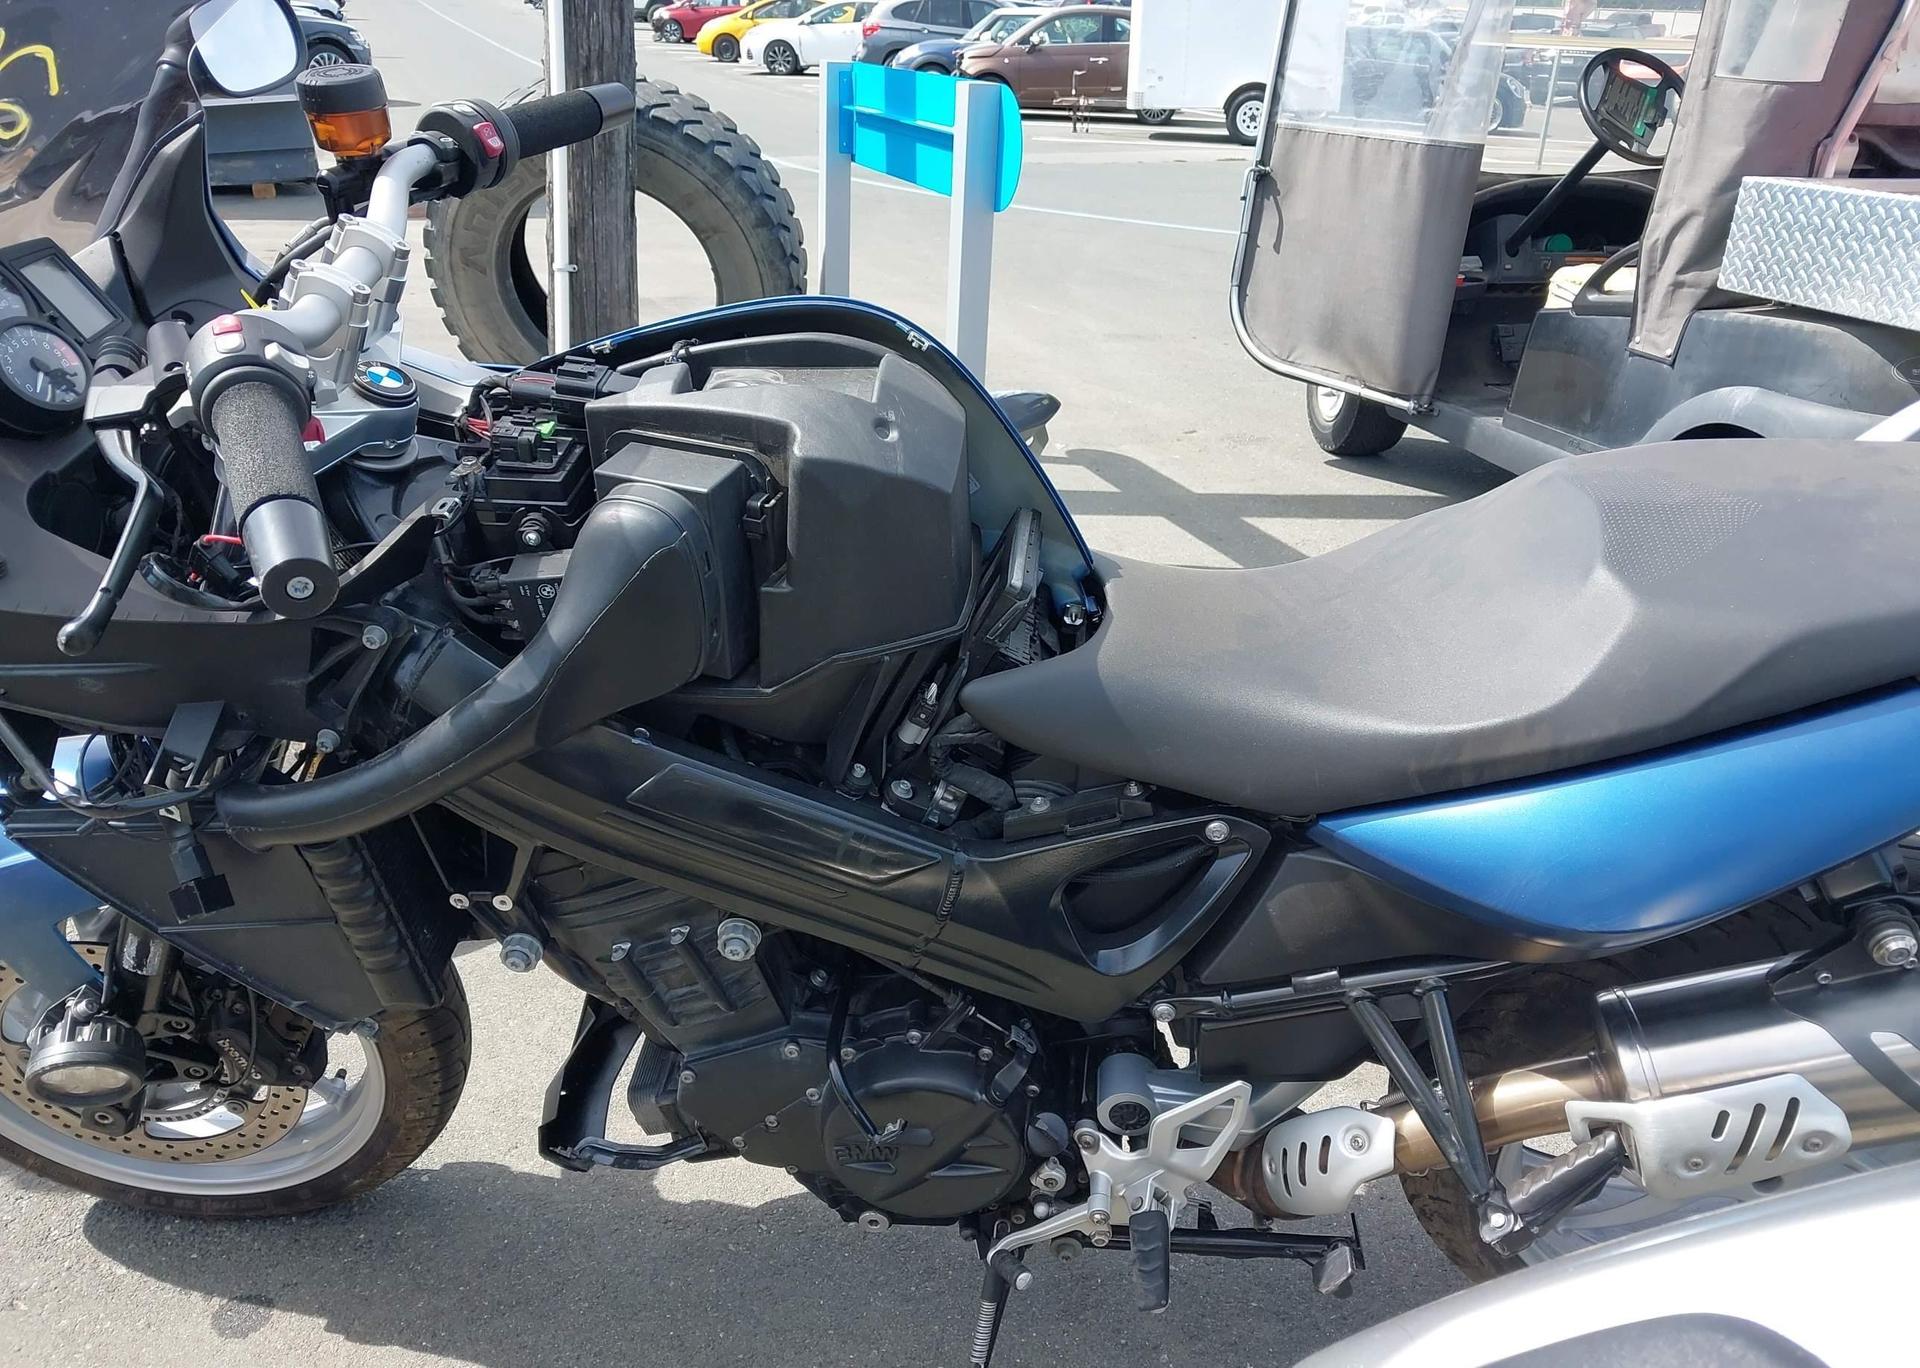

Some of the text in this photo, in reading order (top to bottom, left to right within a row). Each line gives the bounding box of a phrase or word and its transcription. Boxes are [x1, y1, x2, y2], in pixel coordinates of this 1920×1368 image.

[11, 340, 19, 348] 5
[42, 341, 50, 349] 8
[5, 355, 11, 363] 3
[6, 366, 13, 374] 2
[832, 1145, 899, 1161] BMW
